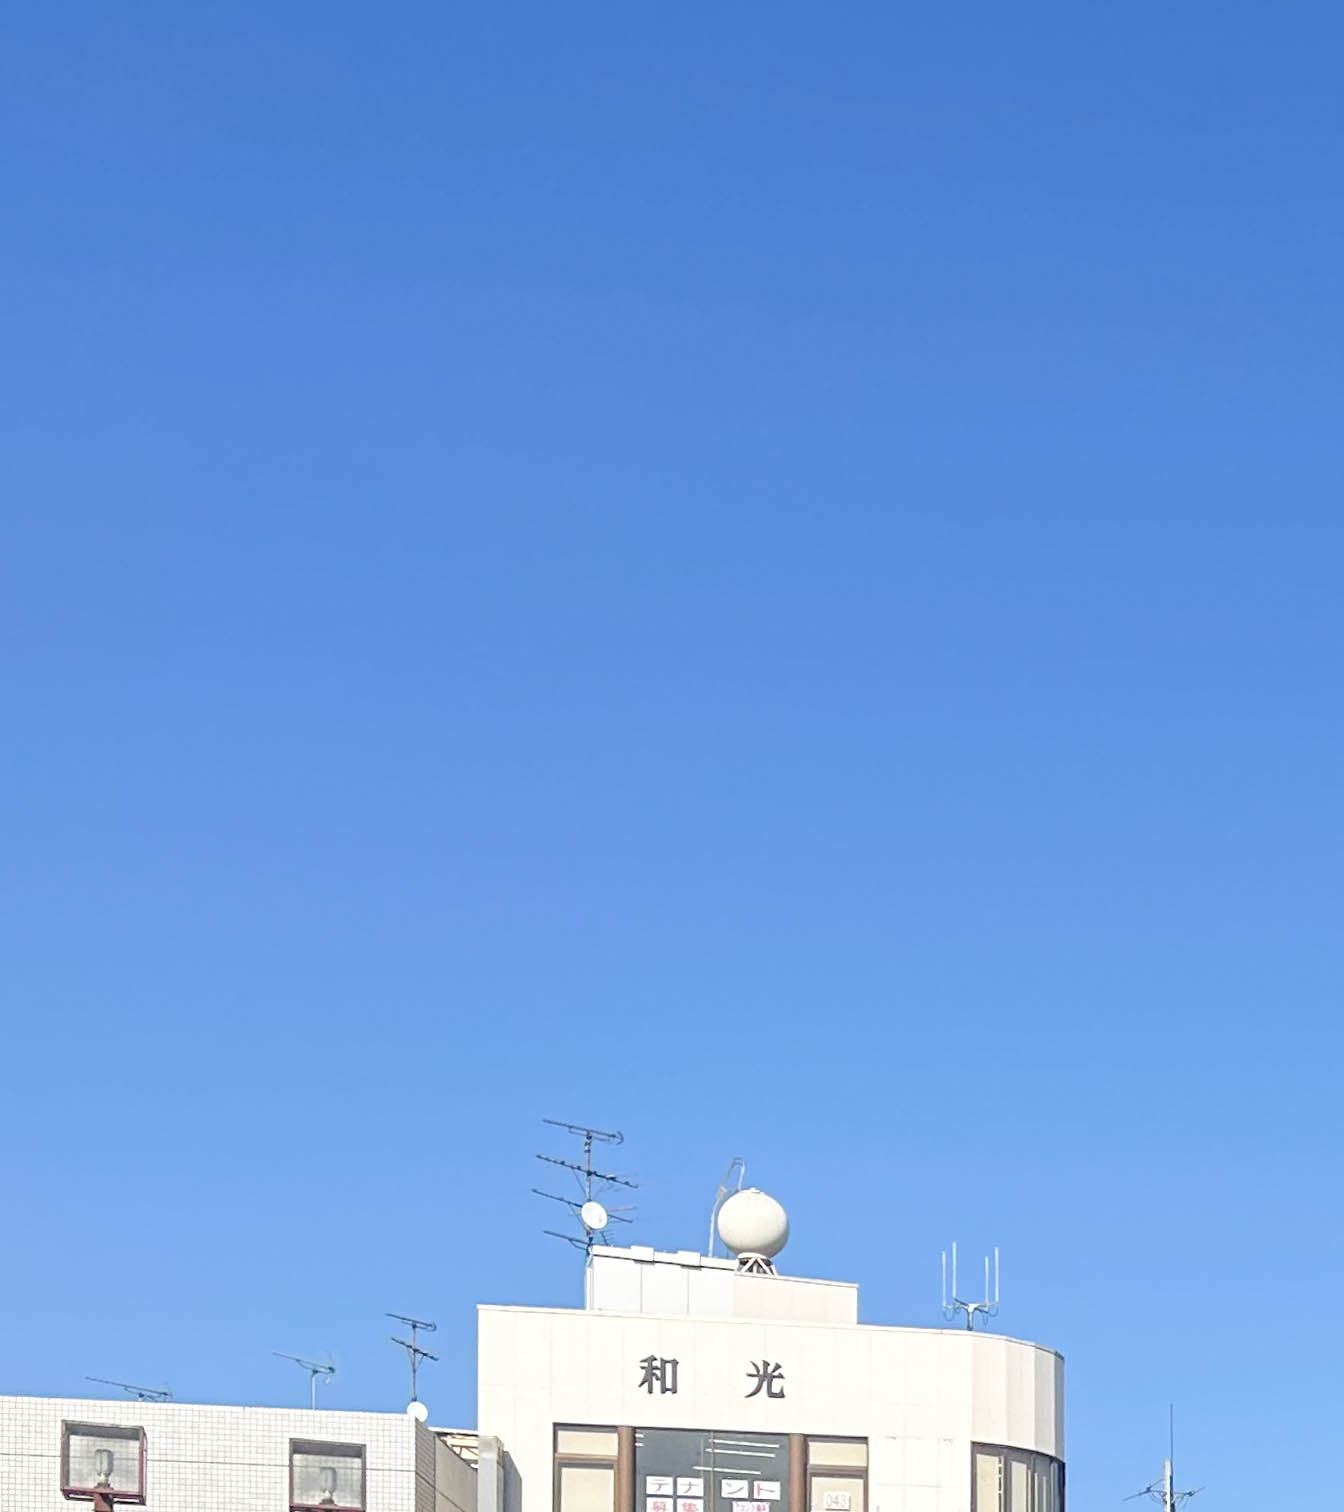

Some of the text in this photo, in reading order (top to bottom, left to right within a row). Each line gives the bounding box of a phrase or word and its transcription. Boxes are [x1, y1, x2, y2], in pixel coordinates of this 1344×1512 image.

[638, 1354, 785, 1399] 和光
[653, 1479, 776, 1498] テナント
